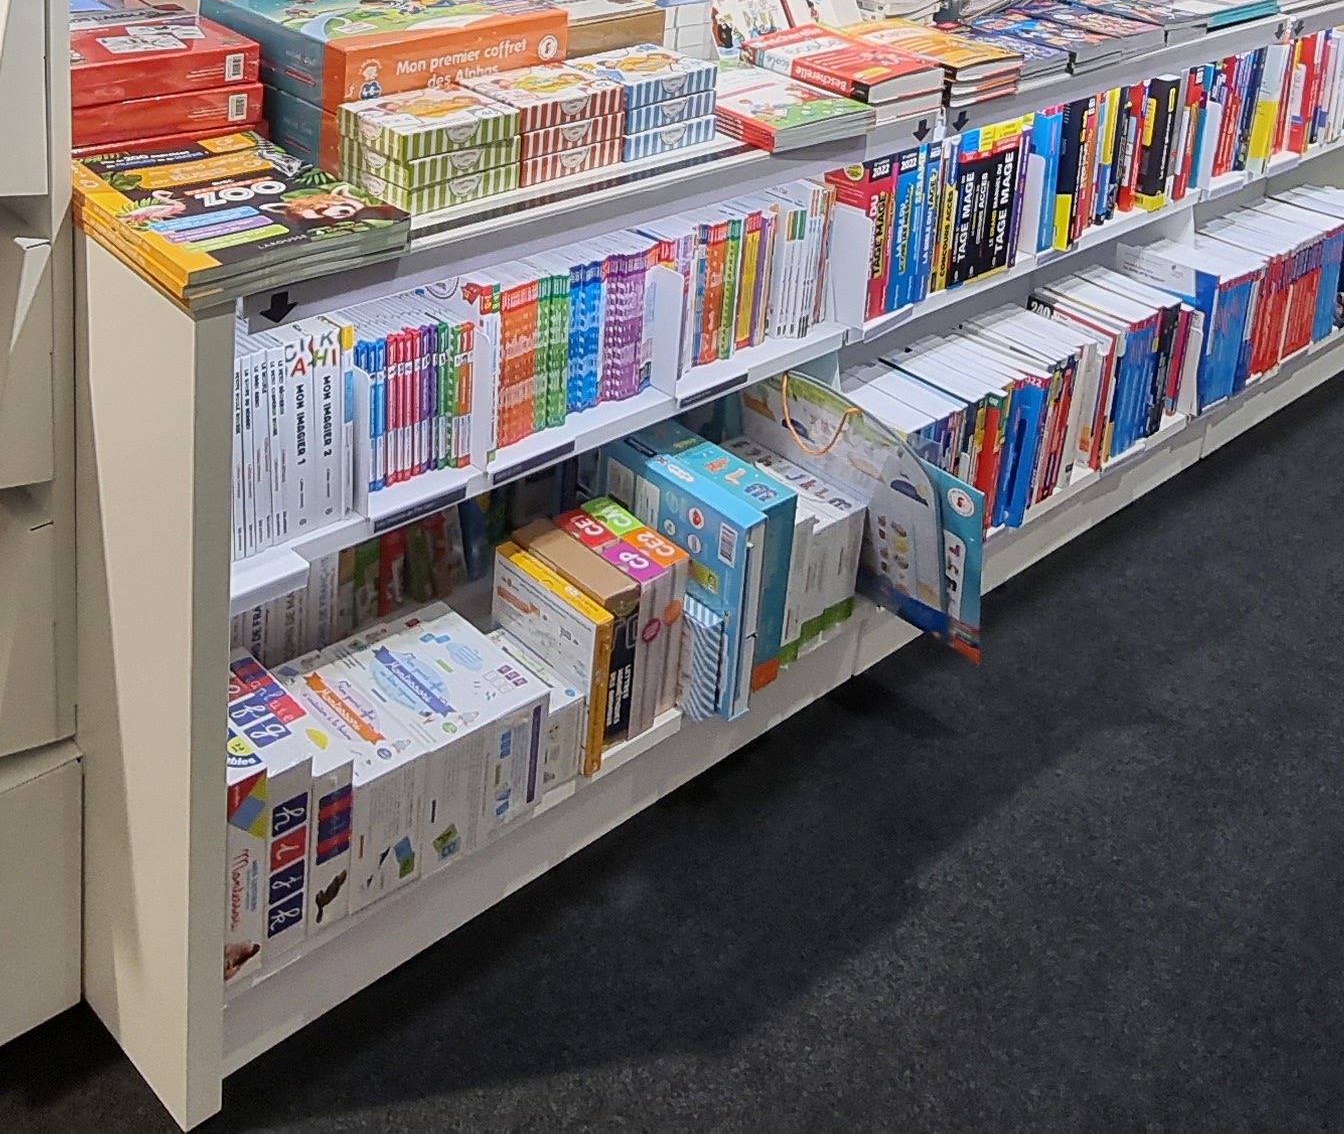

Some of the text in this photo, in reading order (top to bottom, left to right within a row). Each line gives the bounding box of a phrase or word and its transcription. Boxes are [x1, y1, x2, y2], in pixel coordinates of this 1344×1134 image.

[396, 38, 527, 76] Mon premier coffret
[427, 75, 451, 89] des
[794, 65, 849, 93] Bescherelle
[195, 180, 287, 208] ZOO
[994, 152, 1015, 253] TAGE MAGE
[956, 171, 975, 264] TAGE MAGE
[872, 194, 888, 276] TAGE MAGE
[939, 230, 950, 277] CONCOURS
[295, 384, 305, 410] MON
[322, 375, 332, 400] MON
[295, 412, 307, 457] IMAGIER
[323, 403, 333, 446] IMAGIER
[618, 550, 650, 569] CP
[637, 531, 676, 557] CE2
